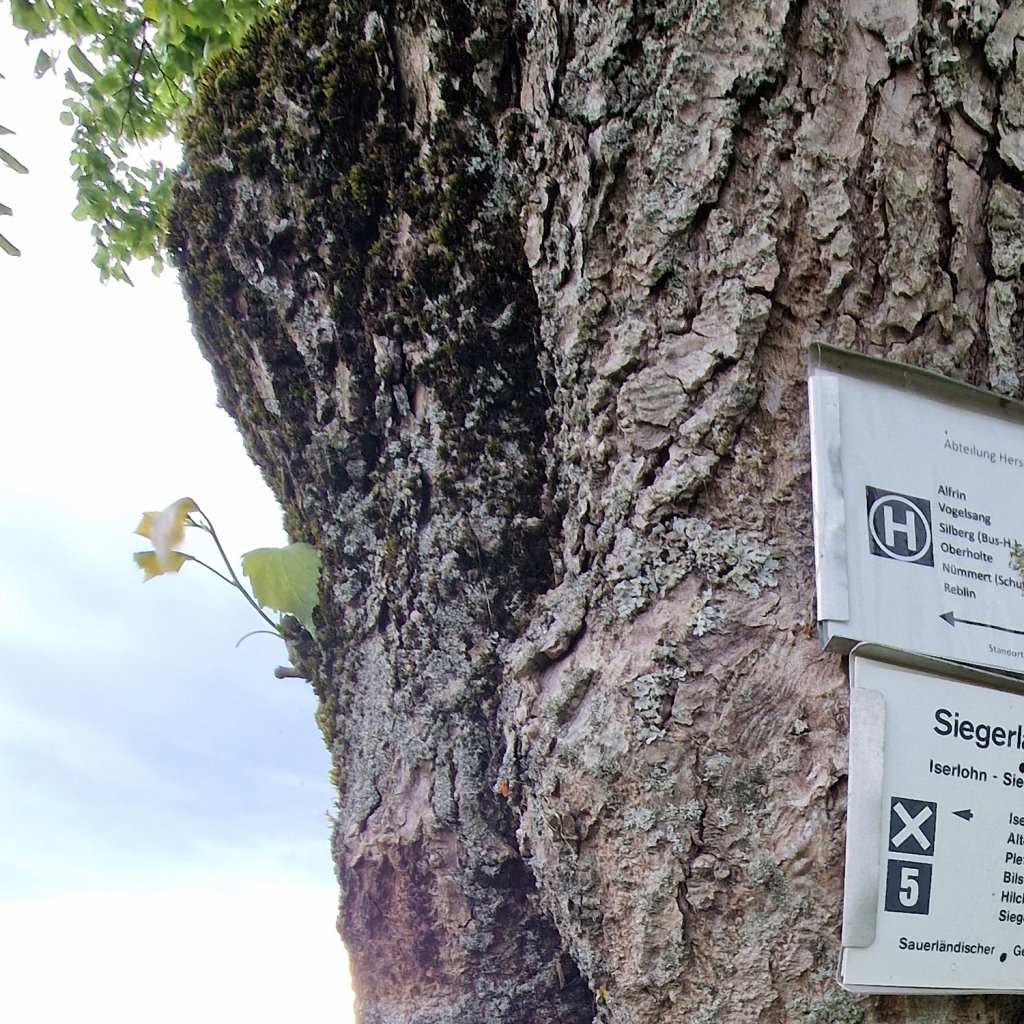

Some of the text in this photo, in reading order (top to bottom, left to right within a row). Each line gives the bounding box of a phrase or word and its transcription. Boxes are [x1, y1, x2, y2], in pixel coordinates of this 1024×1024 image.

[944, 439, 996, 463] Abteilung
[938, 484, 967, 501] Alfrin
[938, 502, 991, 526] Vogelsang
[883, 505, 916, 551] H
[939, 522, 975, 542] Silberg
[940, 542, 993, 563] Oberholte
[942, 562, 992, 583] Nümmert
[944, 582, 976, 599] Reblin
[929, 759, 987, 782] Iserlohn
[899, 867, 920, 907] 5
[899, 937, 995, 955] Sauerländischer
